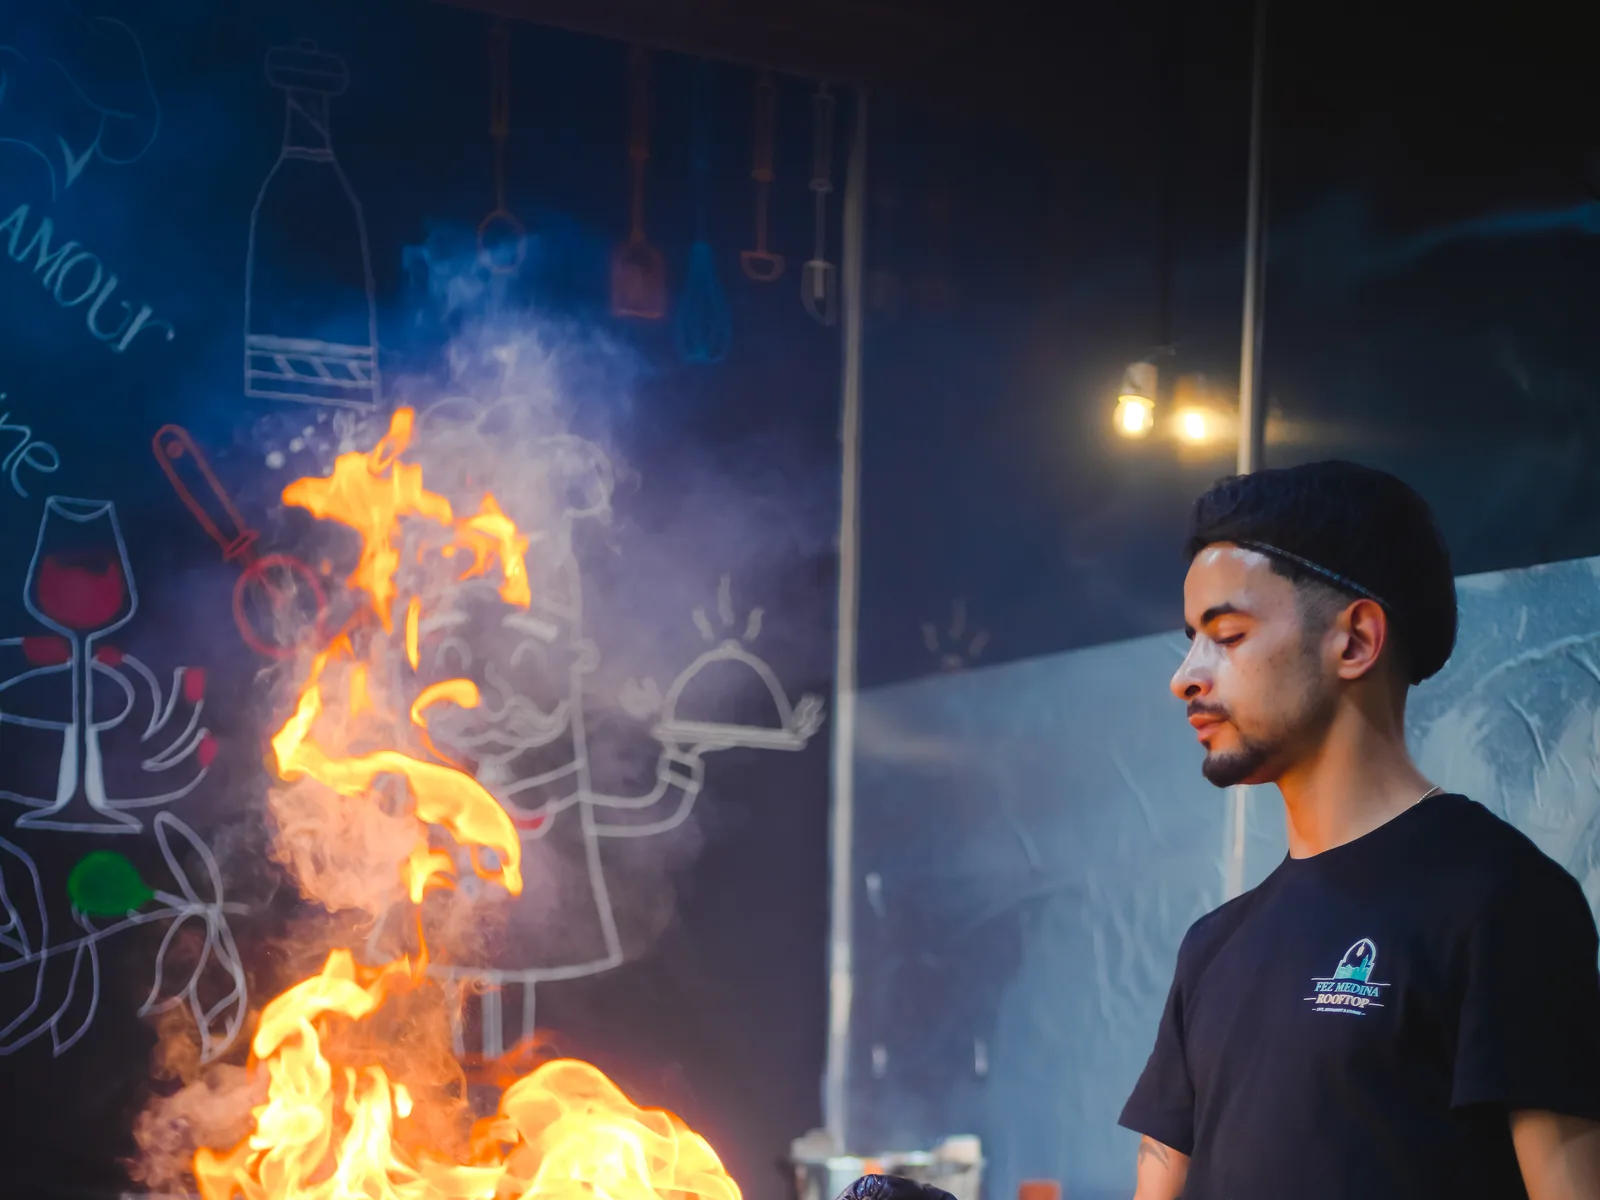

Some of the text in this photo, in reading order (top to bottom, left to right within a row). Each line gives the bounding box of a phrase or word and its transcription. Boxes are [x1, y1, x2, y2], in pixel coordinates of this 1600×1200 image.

[1314, 981, 1379, 997] FEZ MEDINA
[1315, 994, 1370, 1008] ROOFTOP
